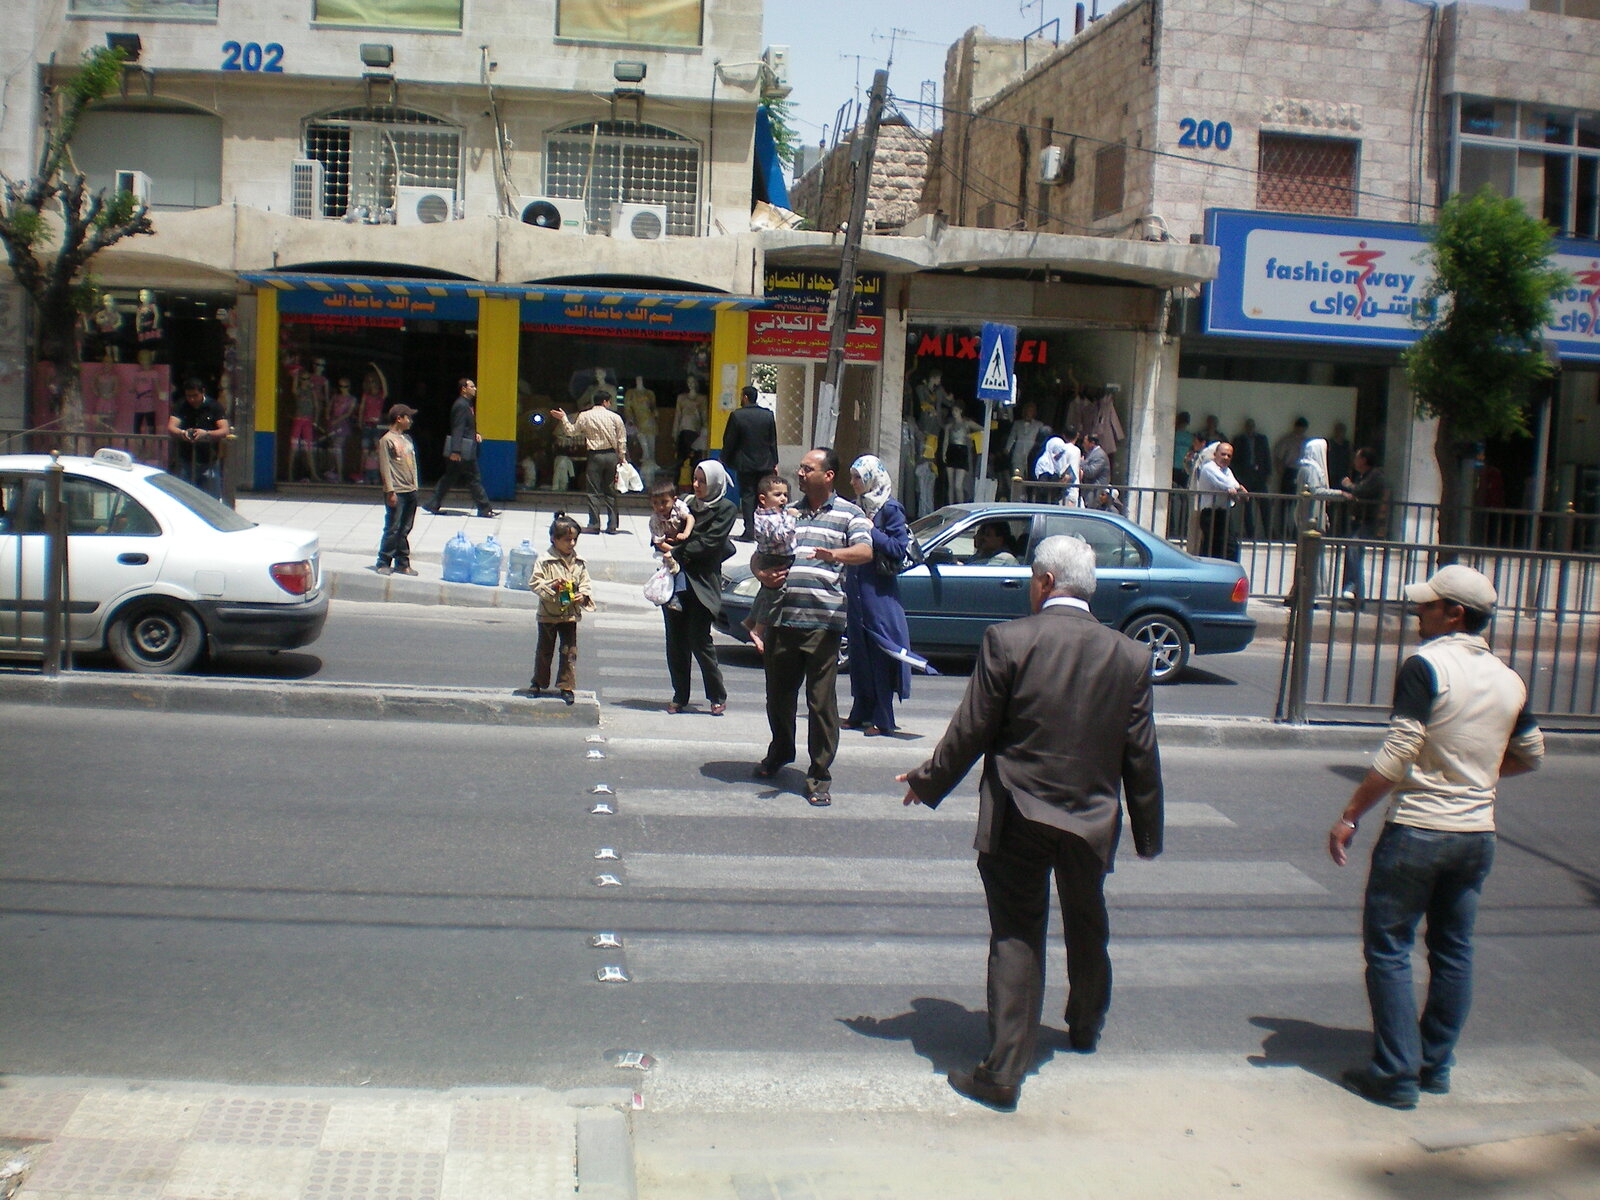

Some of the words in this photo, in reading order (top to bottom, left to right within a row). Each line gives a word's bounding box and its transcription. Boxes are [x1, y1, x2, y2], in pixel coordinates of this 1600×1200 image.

[221, 40, 284, 72] 202
[1178, 117, 1232, 150] 200
[764, 270, 805, 291] الخصاون
[1266, 257, 1360, 285] fashion
[1364, 272, 1416, 291] way
[807, 273, 835, 294] جهاد
[323, 294, 346, 308] الله
[386, 296, 409, 309] الله
[411, 300, 436, 313] بسم
[564, 305, 587, 318] الله
[625, 307, 648, 321] الله
[649, 312, 673, 324] بسم
[754, 314, 813, 335] الكيلاني
